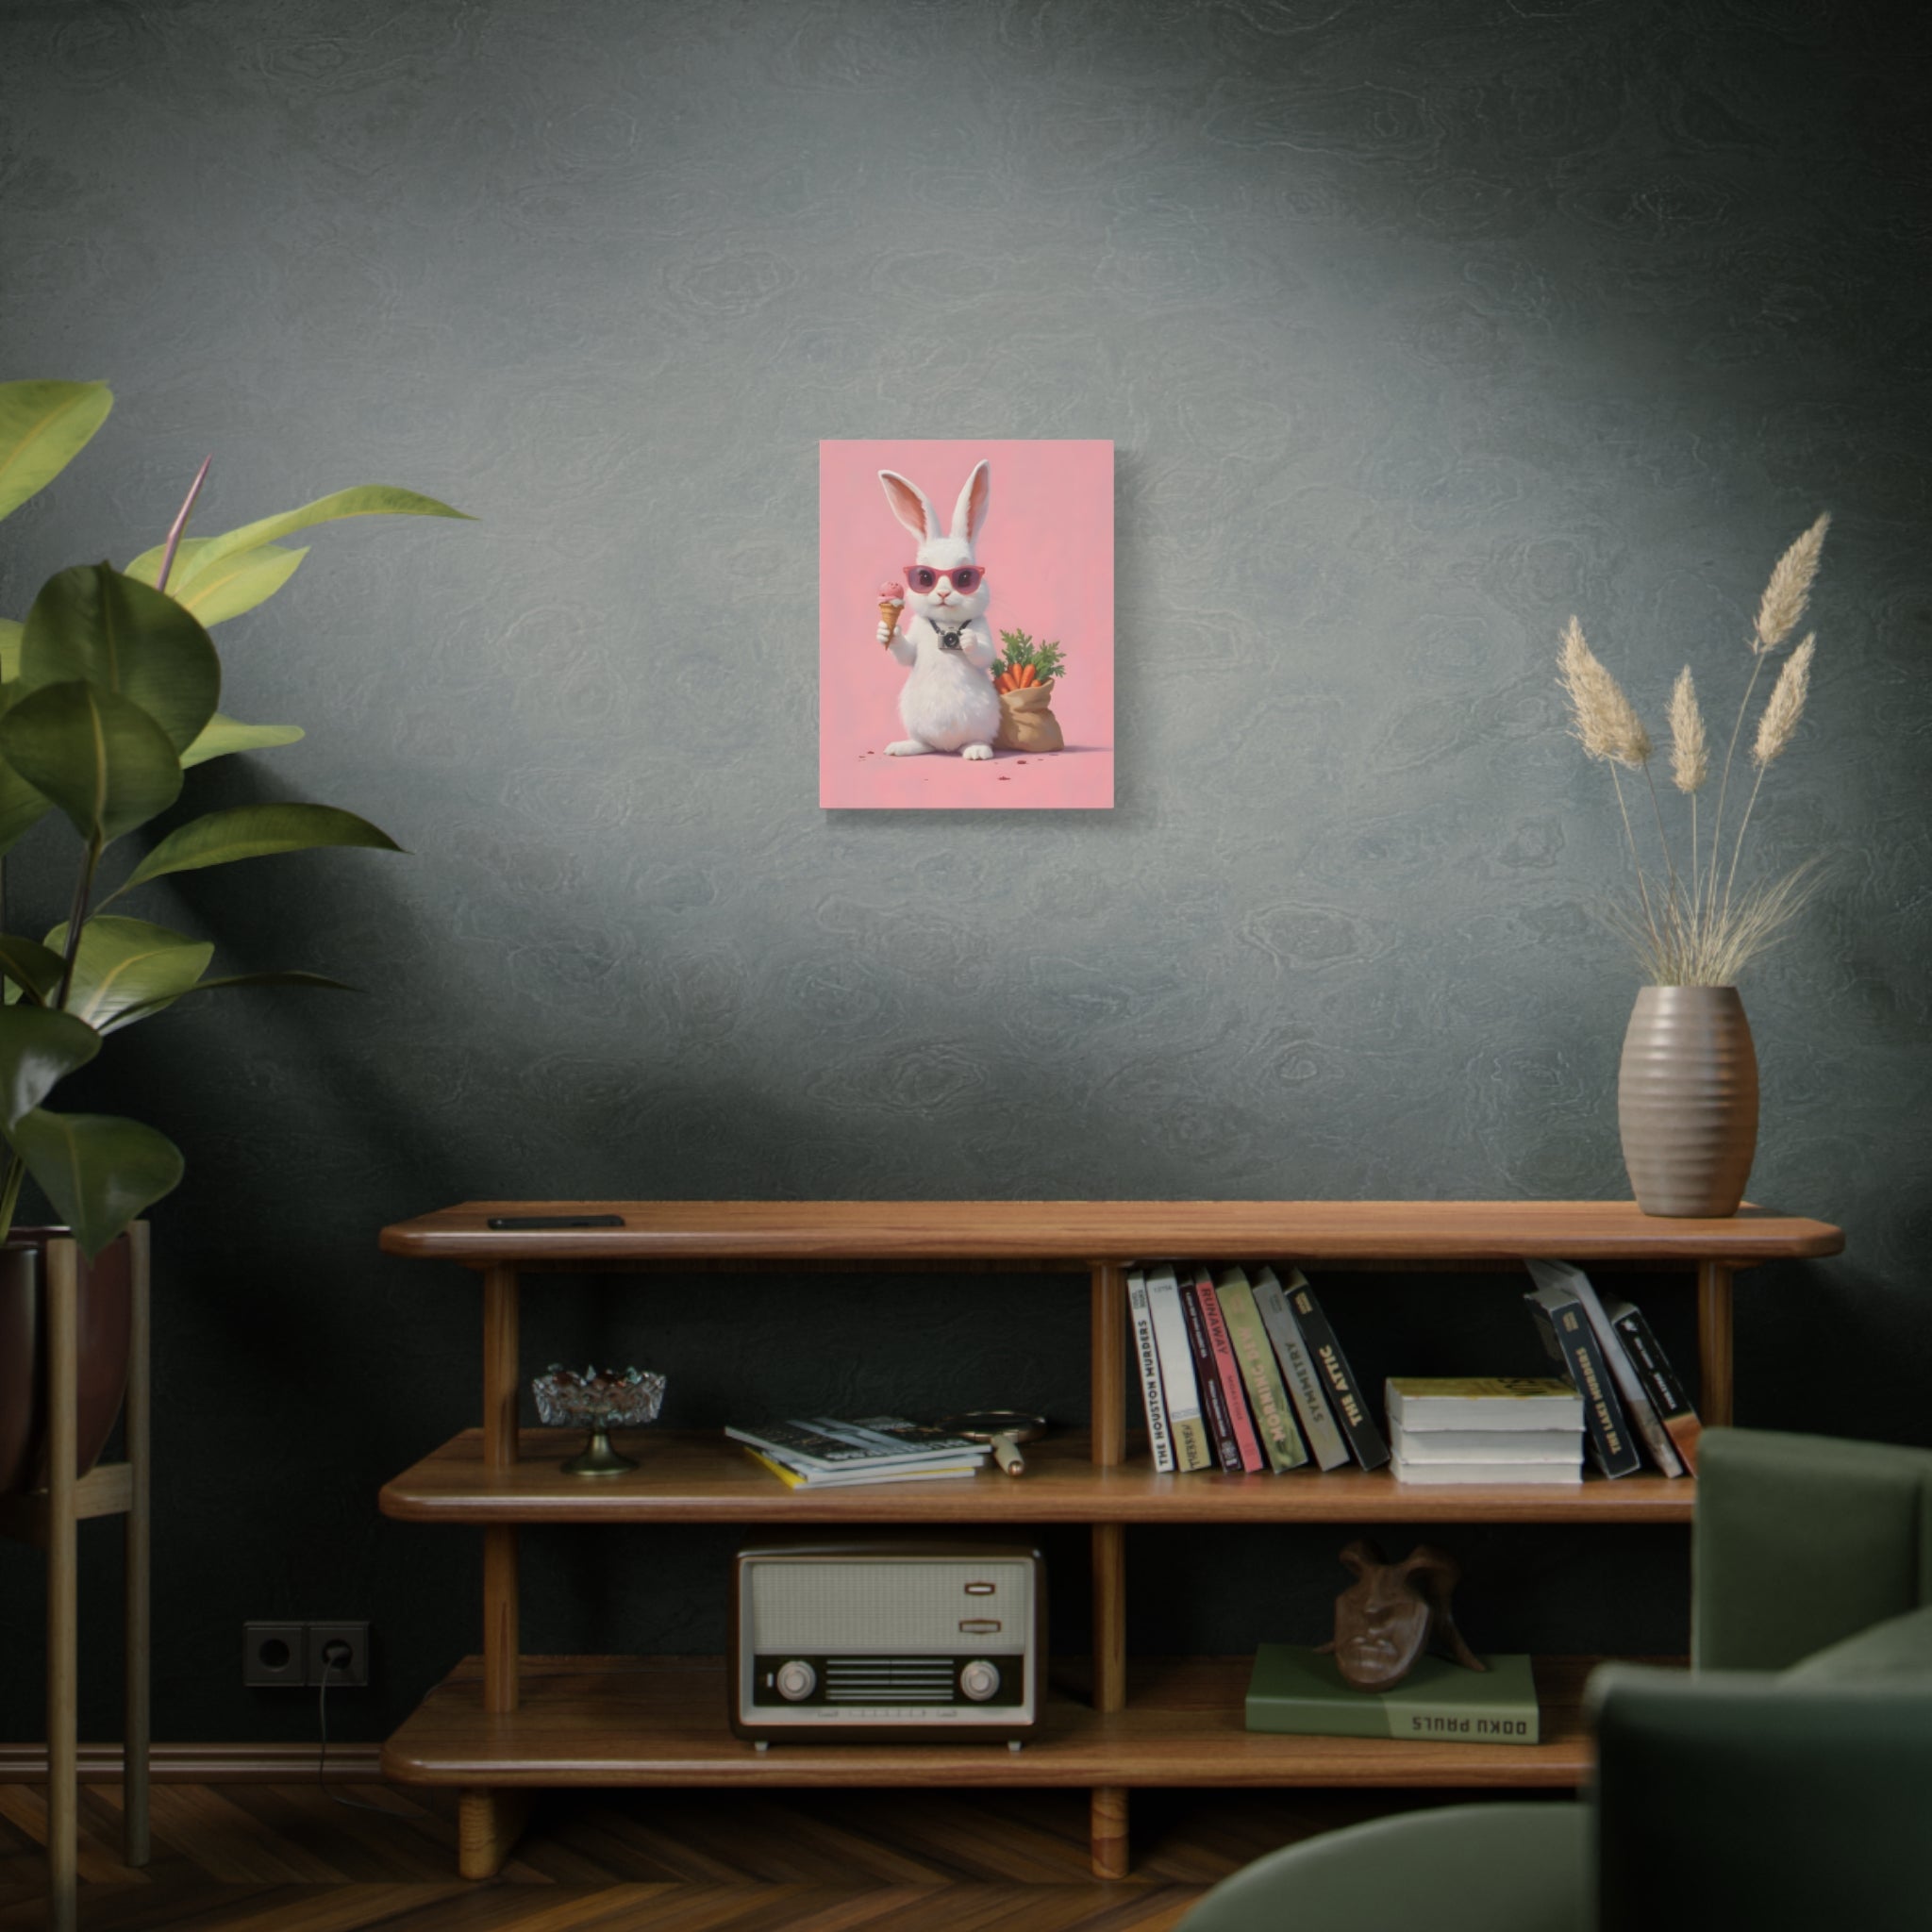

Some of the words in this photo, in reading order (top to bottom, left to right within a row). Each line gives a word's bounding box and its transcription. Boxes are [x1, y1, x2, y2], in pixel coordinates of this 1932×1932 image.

[1200, 1288, 1228, 1355] RUNAWAY
[1238, 1326, 1261, 1361] DEW
[1138, 1320, 1157, 1377] MURDERS
[1318, 1344, 1350, 1391] ATTIC
[1574, 1346, 1604, 1402] MURDERS
[1250, 1364, 1287, 1442] MORNING
[1285, 1341, 1324, 1423] SYMMETRY
[1147, 1380, 1165, 1441] HOUSTON
[1340, 1392, 1364, 1428] THE
[1157, 1443, 1170, 1466] THE
[1606, 1430, 1623, 1456] THE
[1412, 1716, 1471, 1734] PAULS
